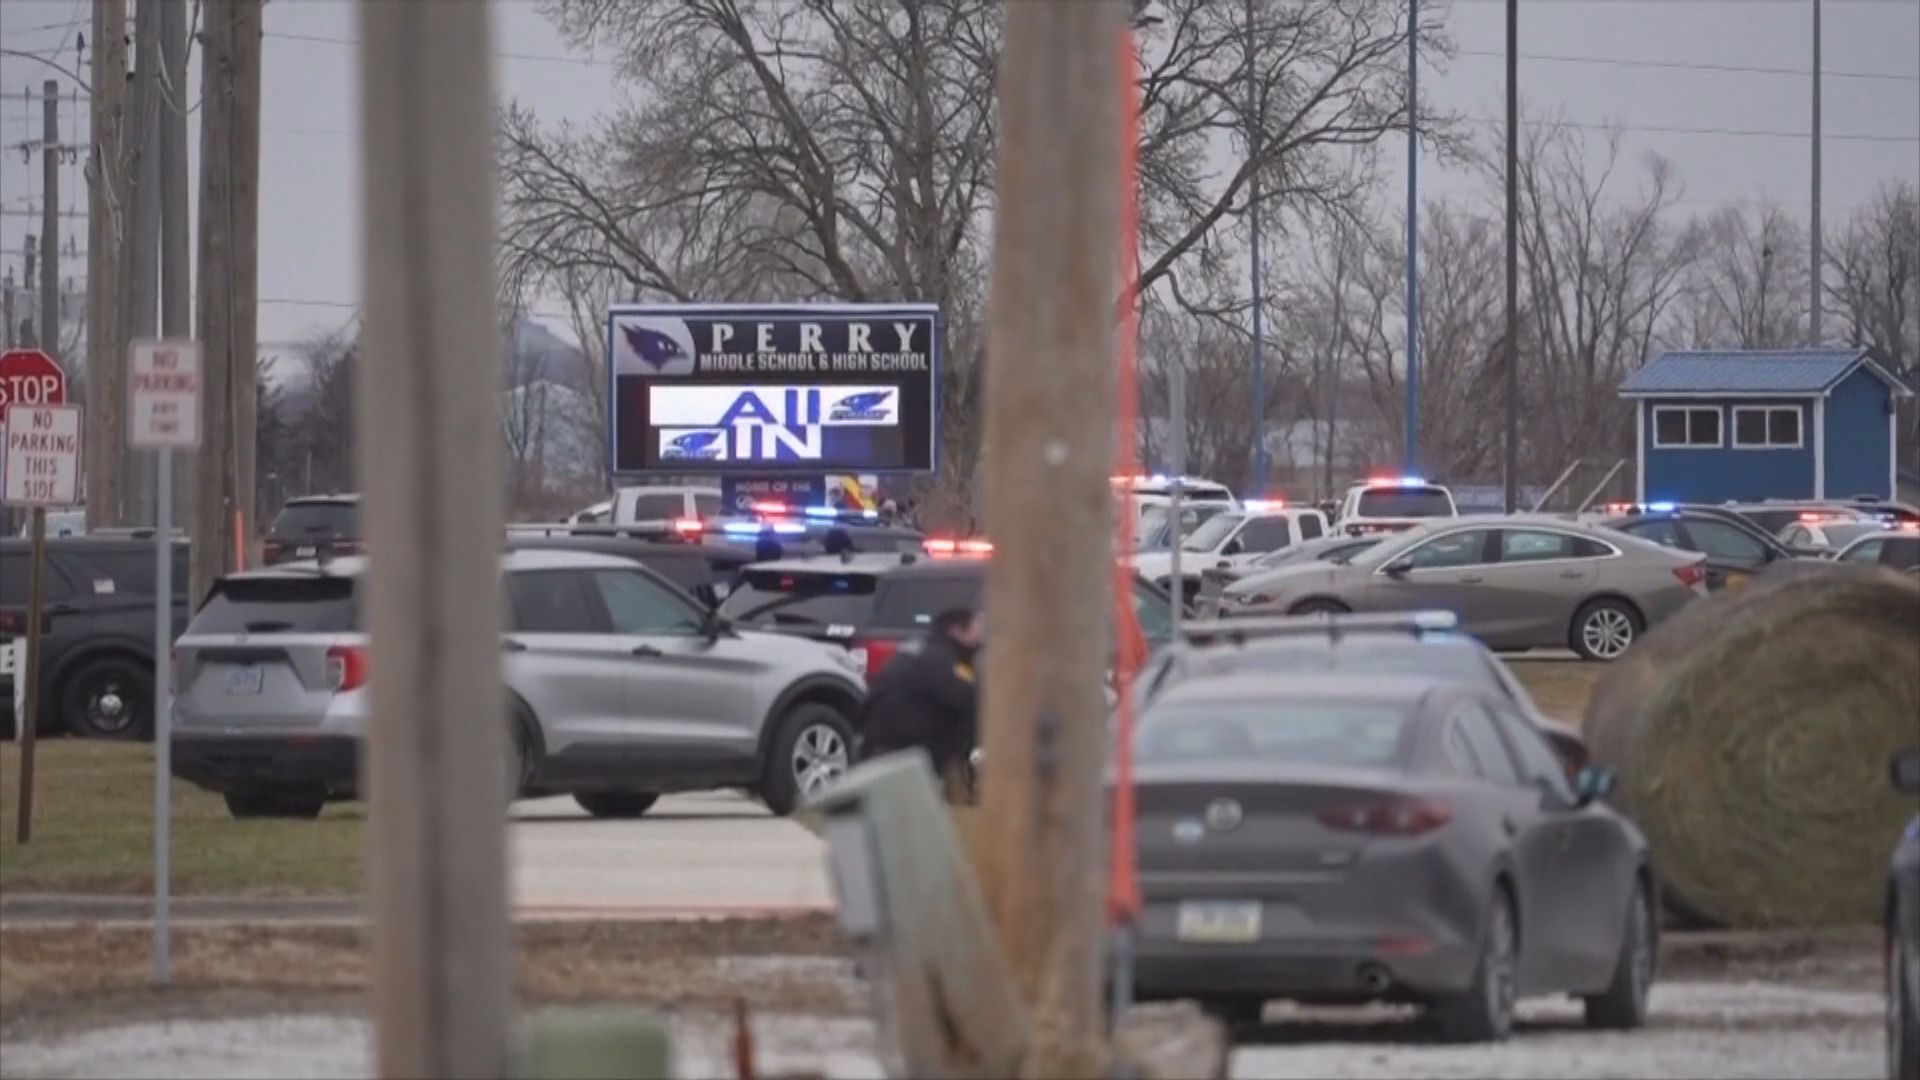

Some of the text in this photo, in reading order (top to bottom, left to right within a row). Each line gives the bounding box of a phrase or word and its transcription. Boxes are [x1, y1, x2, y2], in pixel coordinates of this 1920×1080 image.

[711, 322, 917, 353] PERRY
[152, 351, 178, 369] NO
[700, 353, 929, 370] MIDDLE SCHOOL & HIGH SCHOOL
[32, 411, 53, 428] NO
[10, 434, 75, 453] PARKING
[24, 457, 57, 475] THIS
[23, 480, 56, 498] SIDE
